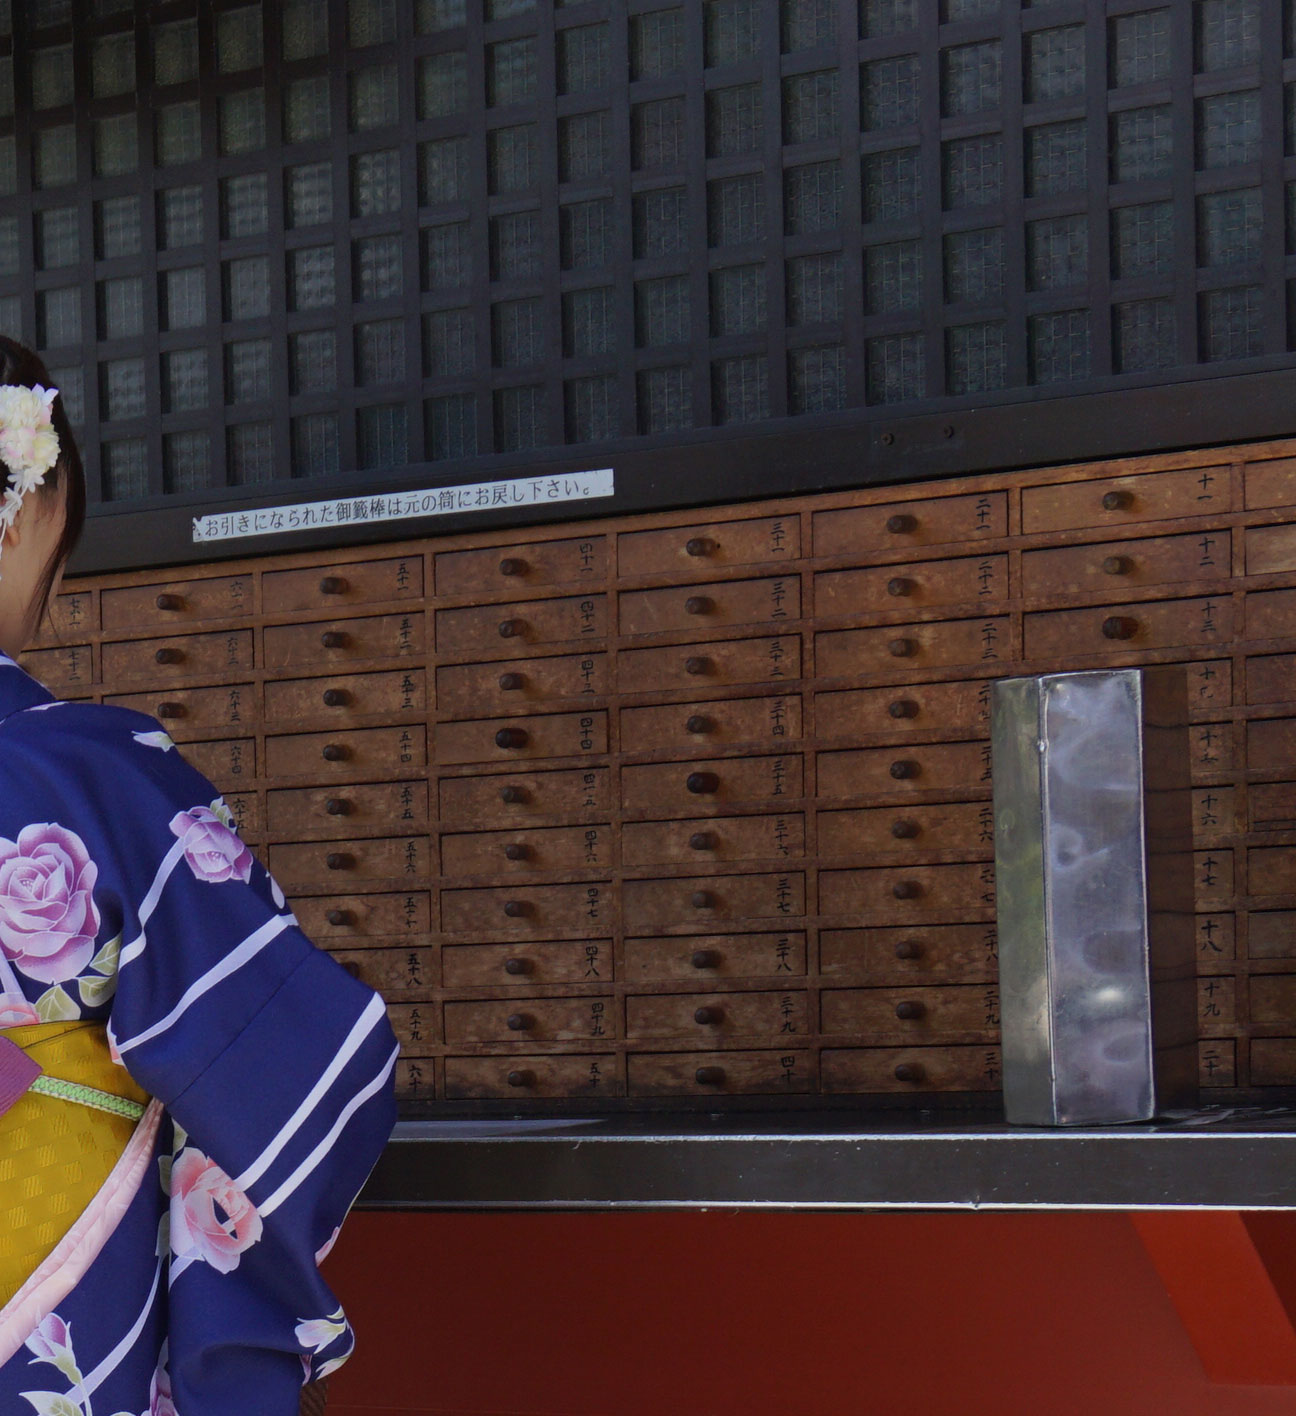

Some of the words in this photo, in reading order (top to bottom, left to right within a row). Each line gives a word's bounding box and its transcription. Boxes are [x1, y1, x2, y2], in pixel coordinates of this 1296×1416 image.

[1197, 473, 1214, 500] 十一
[976, 498, 991, 530] 二十一
[770, 523, 785, 552] 三十一
[1199, 537, 1215, 565] 十二
[579, 543, 593, 571] 四十一
[398, 564, 409, 591] 五十一
[978, 561, 992, 595] 二十二
[771, 582, 787, 618] 三十二
[399, 616, 413, 649] 五十二
[580, 601, 595, 633] 四十二
[1201, 601, 1217, 632] 十三
[228, 637, 239, 665] 六十二
[982, 623, 998, 659] 二十三
[69, 650, 80, 681] 七十二
[769, 642, 784, 676] 三十三
[401, 675, 414, 708] 五十三
[581, 660, 595, 693] 四十三
[229, 690, 240, 722] 六十三
[770, 702, 785, 736] 三十四
[400, 731, 412, 762] 五十四
[580, 717, 593, 749] 四十四
[231, 746, 242, 773] 六十四
[980, 746, 992, 781] 二十五
[772, 760, 785, 795] 三十五
[234, 798, 248, 829] 六十五
[401, 787, 414, 819] 五十五
[1201, 794, 1218, 825] 十六
[979, 808, 993, 842] 二十六
[405, 841, 417, 873] 五十六
[585, 830, 597, 862] 四十六
[1202, 857, 1218, 885] 十七
[587, 888, 598, 917] 四十七
[776, 879, 792, 913] 三十七
[984, 930, 998, 961] 二十八
[1201, 920, 1222, 952] 十八
[408, 953, 422, 985] 五十八
[585, 946, 599, 977] 四十八
[776, 938, 792, 971] 三十八
[781, 997, 796, 1033] 三十九
[984, 991, 1000, 1025] 二十九
[1203, 982, 1221, 1016] 十九
[410, 1009, 422, 1041] 五十九
[591, 1002, 605, 1036] 四十九
[409, 1065, 422, 1092] 六十
[590, 1063, 600, 1088] 五十
[781, 1055, 795, 1083] 四十
[984, 1052, 998, 1080] 三十
[1202, 1050, 1219, 1076] 二十
